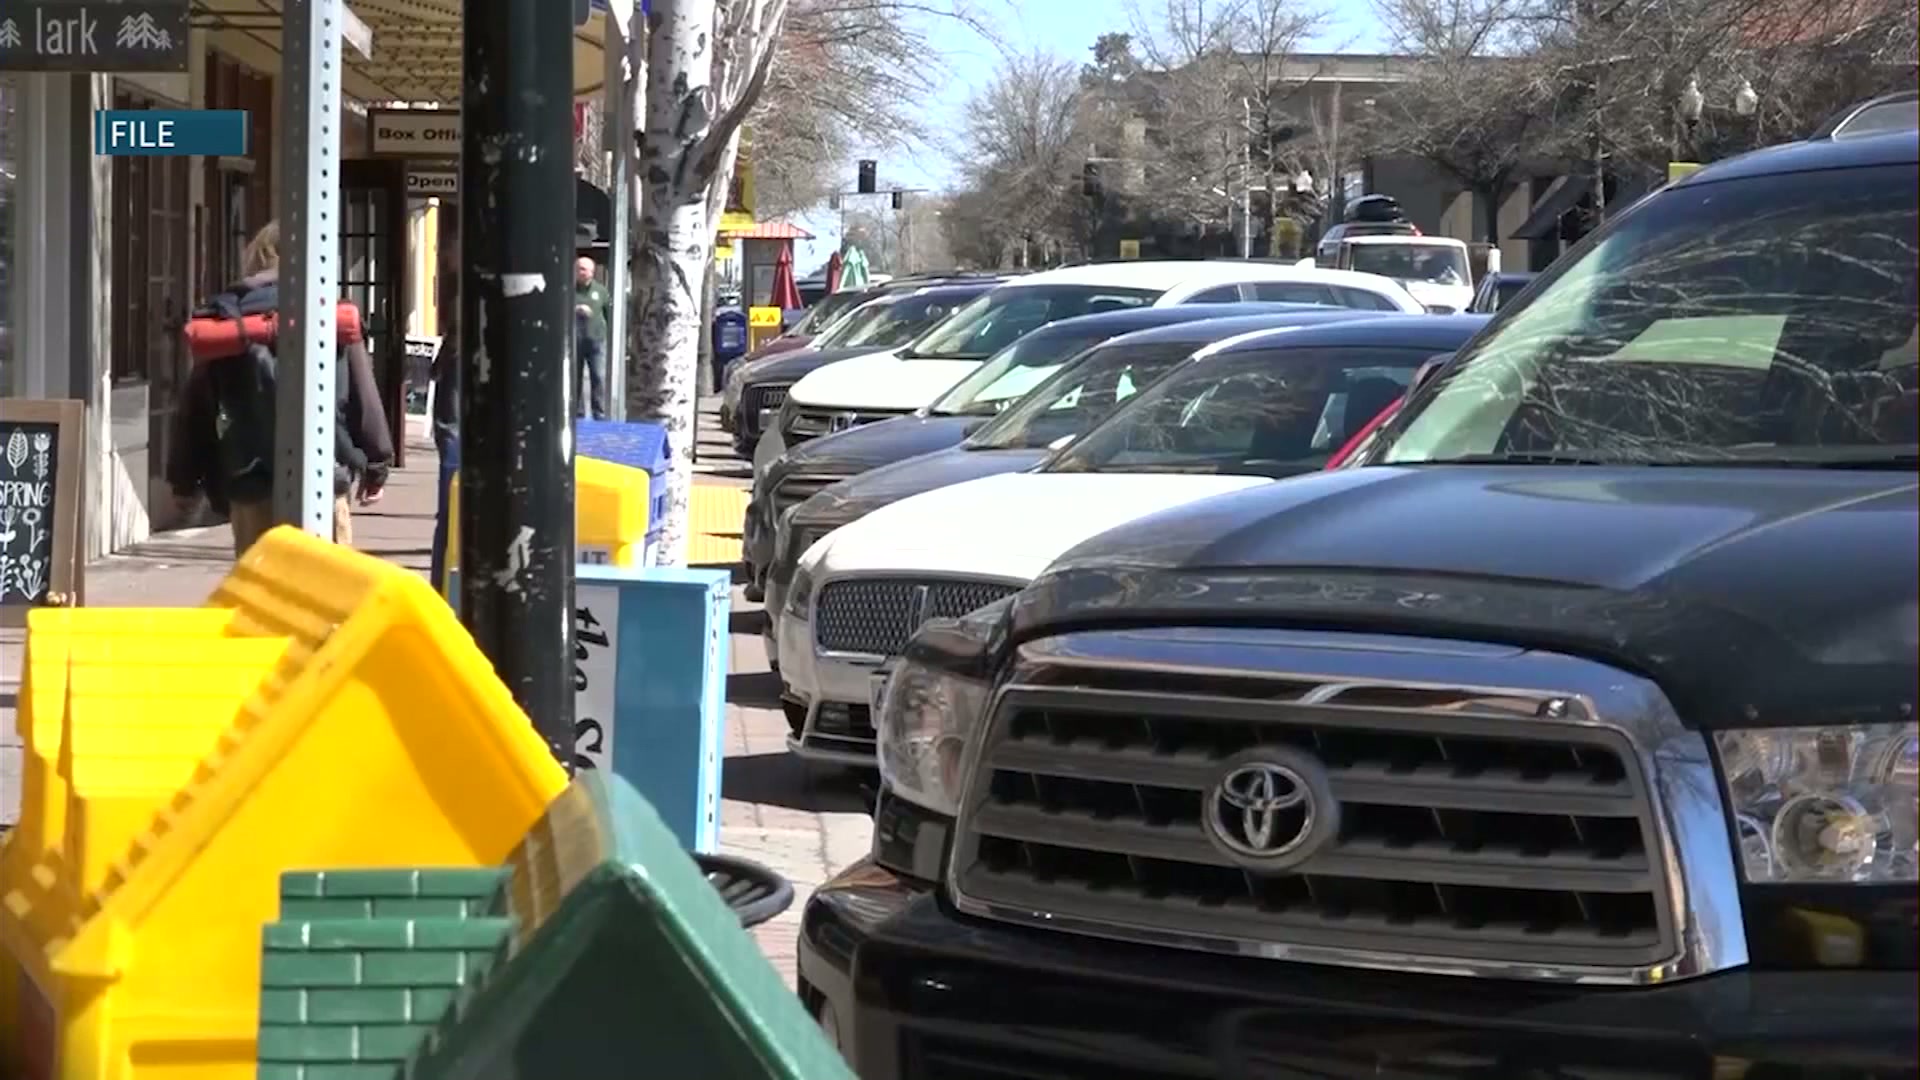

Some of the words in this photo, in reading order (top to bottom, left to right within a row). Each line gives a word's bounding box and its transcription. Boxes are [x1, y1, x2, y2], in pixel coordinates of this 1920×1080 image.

[36, 7, 98, 54] lark
[378, 127, 415, 140] Box
[408, 175, 455, 188] Open
